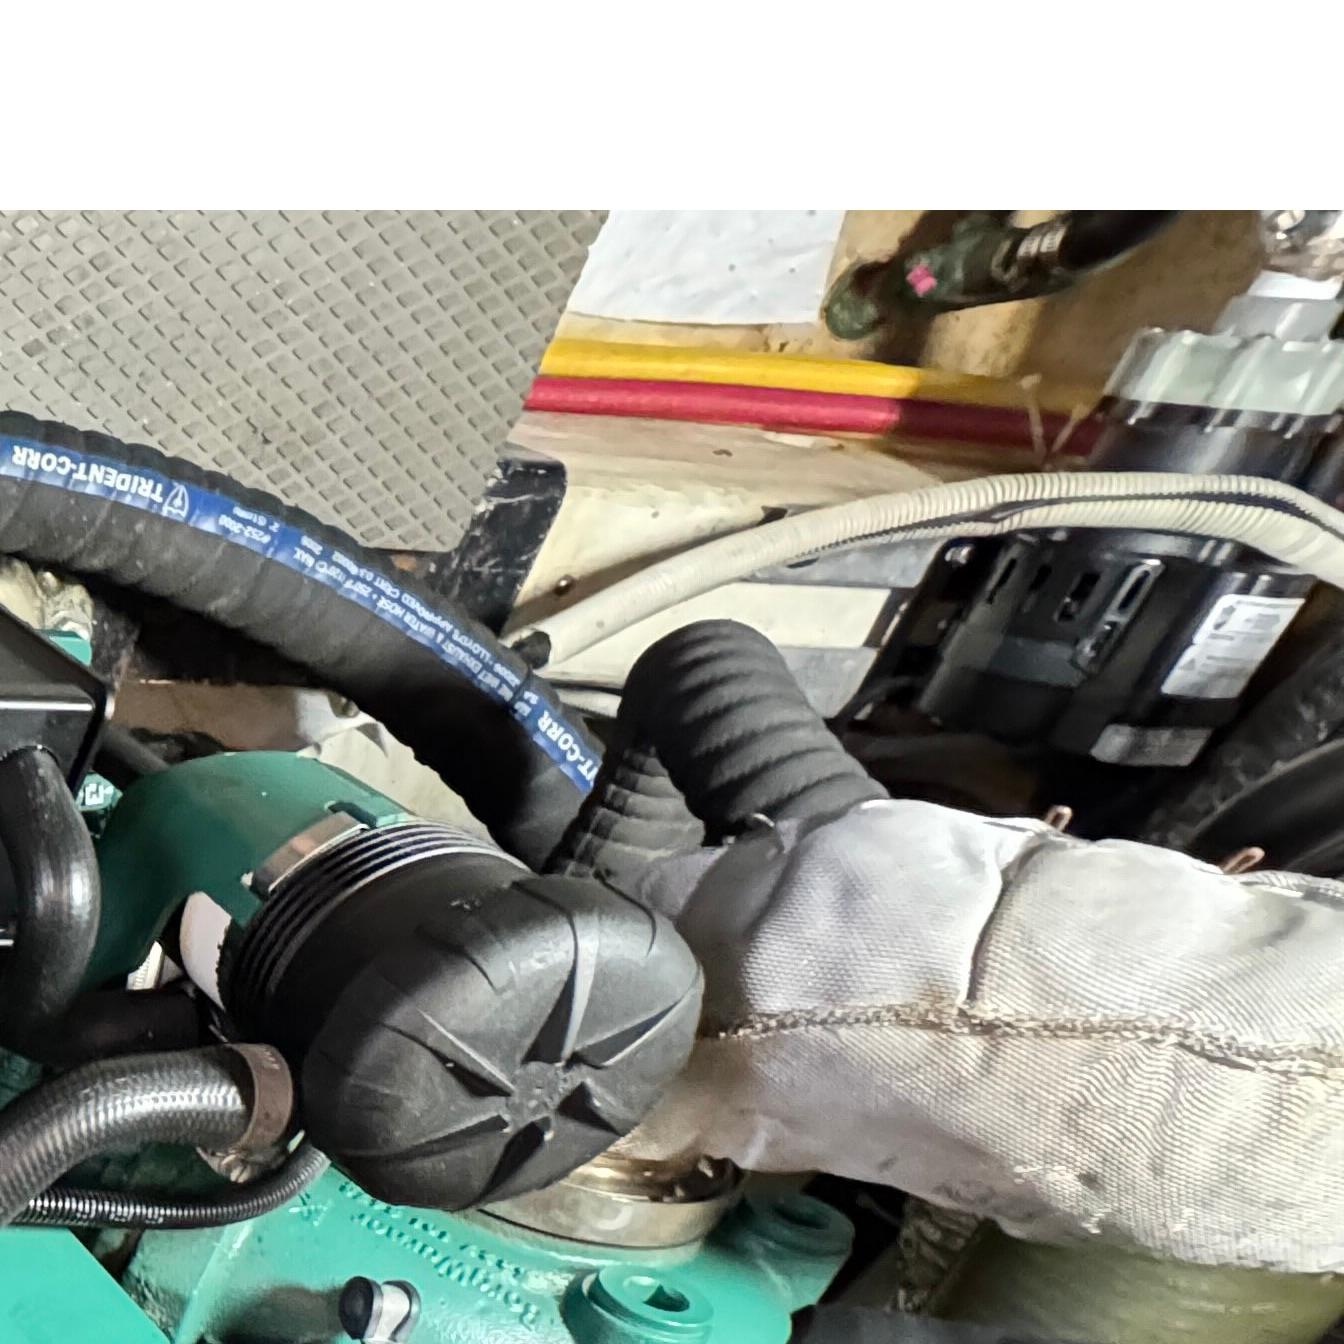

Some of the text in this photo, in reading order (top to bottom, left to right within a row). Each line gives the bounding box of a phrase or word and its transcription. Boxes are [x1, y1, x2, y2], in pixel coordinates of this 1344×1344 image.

[12, 445, 163, 503] TRIDENT-CORR
[374, 576, 400, 599] CERT
[376, 598, 406, 618] HOSE
[404, 613, 436, 638] WATER
